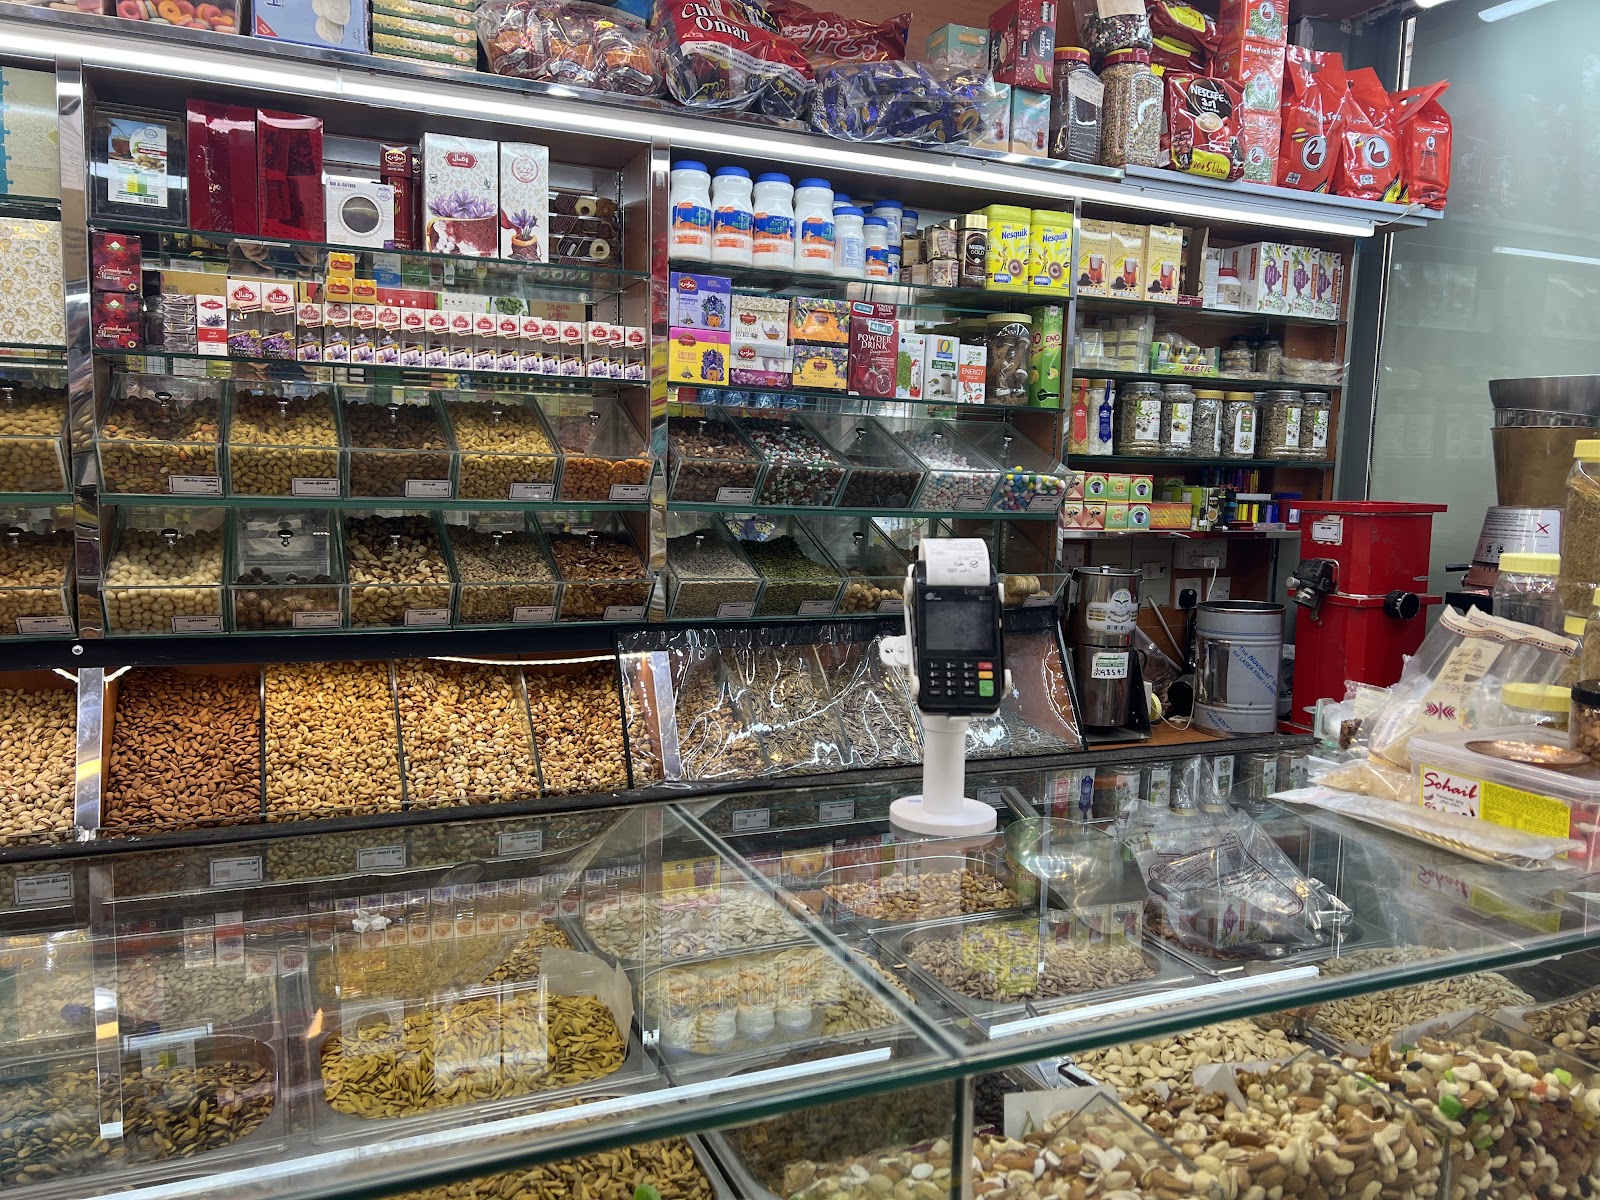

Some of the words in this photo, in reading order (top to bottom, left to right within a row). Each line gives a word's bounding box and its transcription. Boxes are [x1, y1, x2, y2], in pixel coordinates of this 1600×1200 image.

[695, 16, 751, 43] Oman
[452, 154, 469, 163] وصال
[1001, 228, 1028, 239] Nesquik
[1042, 232, 1068, 243] Nesquik
[236, 290, 253, 299] وصال
[269, 293, 286, 302] وصال
[857, 333, 892, 343] POWDER
[1045, 334, 1060, 343] ENO
[861, 341, 887, 350] DRINK
[1183, 365, 1213, 374] MASTIC
[1238, 645, 1249, 656] The
[1232, 650, 1240, 658] for
[1240, 656, 1254, 671] LASER
[1252, 669, 1264, 682] Fiber
[1424, 772, 1480, 800] Sohail
